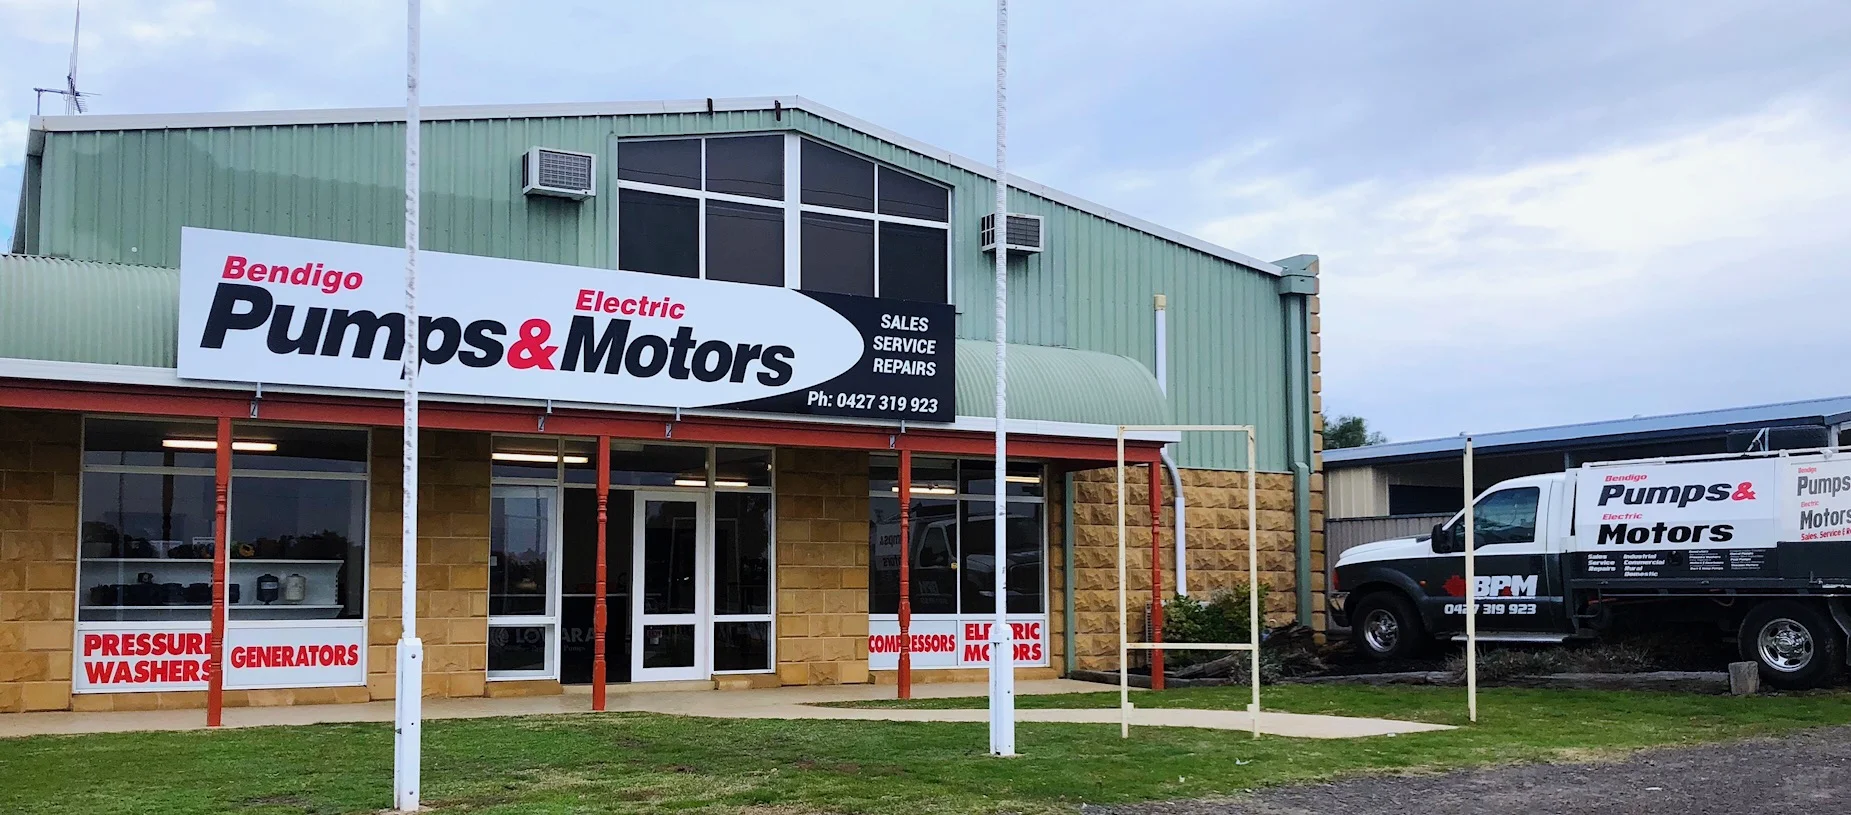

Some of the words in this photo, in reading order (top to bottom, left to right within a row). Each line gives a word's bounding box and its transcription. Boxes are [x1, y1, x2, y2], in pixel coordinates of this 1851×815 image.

[222, 255, 363, 294] Bendigo
[575, 288, 686, 320] Electric
[880, 313, 930, 332] SALES
[872, 335, 937, 355] SERVICE
[872, 357, 937, 377] REPAIRS
[807, 390, 834, 407] Ph:
[836, 393, 875, 409] 0427
[878, 395, 907, 412] 319
[910, 396, 939, 413] 923
[1605, 474, 1648, 483] Bendigo
[1797, 475, 1851, 498] Pumps
[1602, 513, 1643, 521] Electric
[1800, 507, 1851, 531] Motors
[1597, 522, 1734, 545] Motors
[1482, 604, 1505, 615] 319
[1508, 604, 1537, 615] 923
[230, 644, 359, 669] GENERATORS
